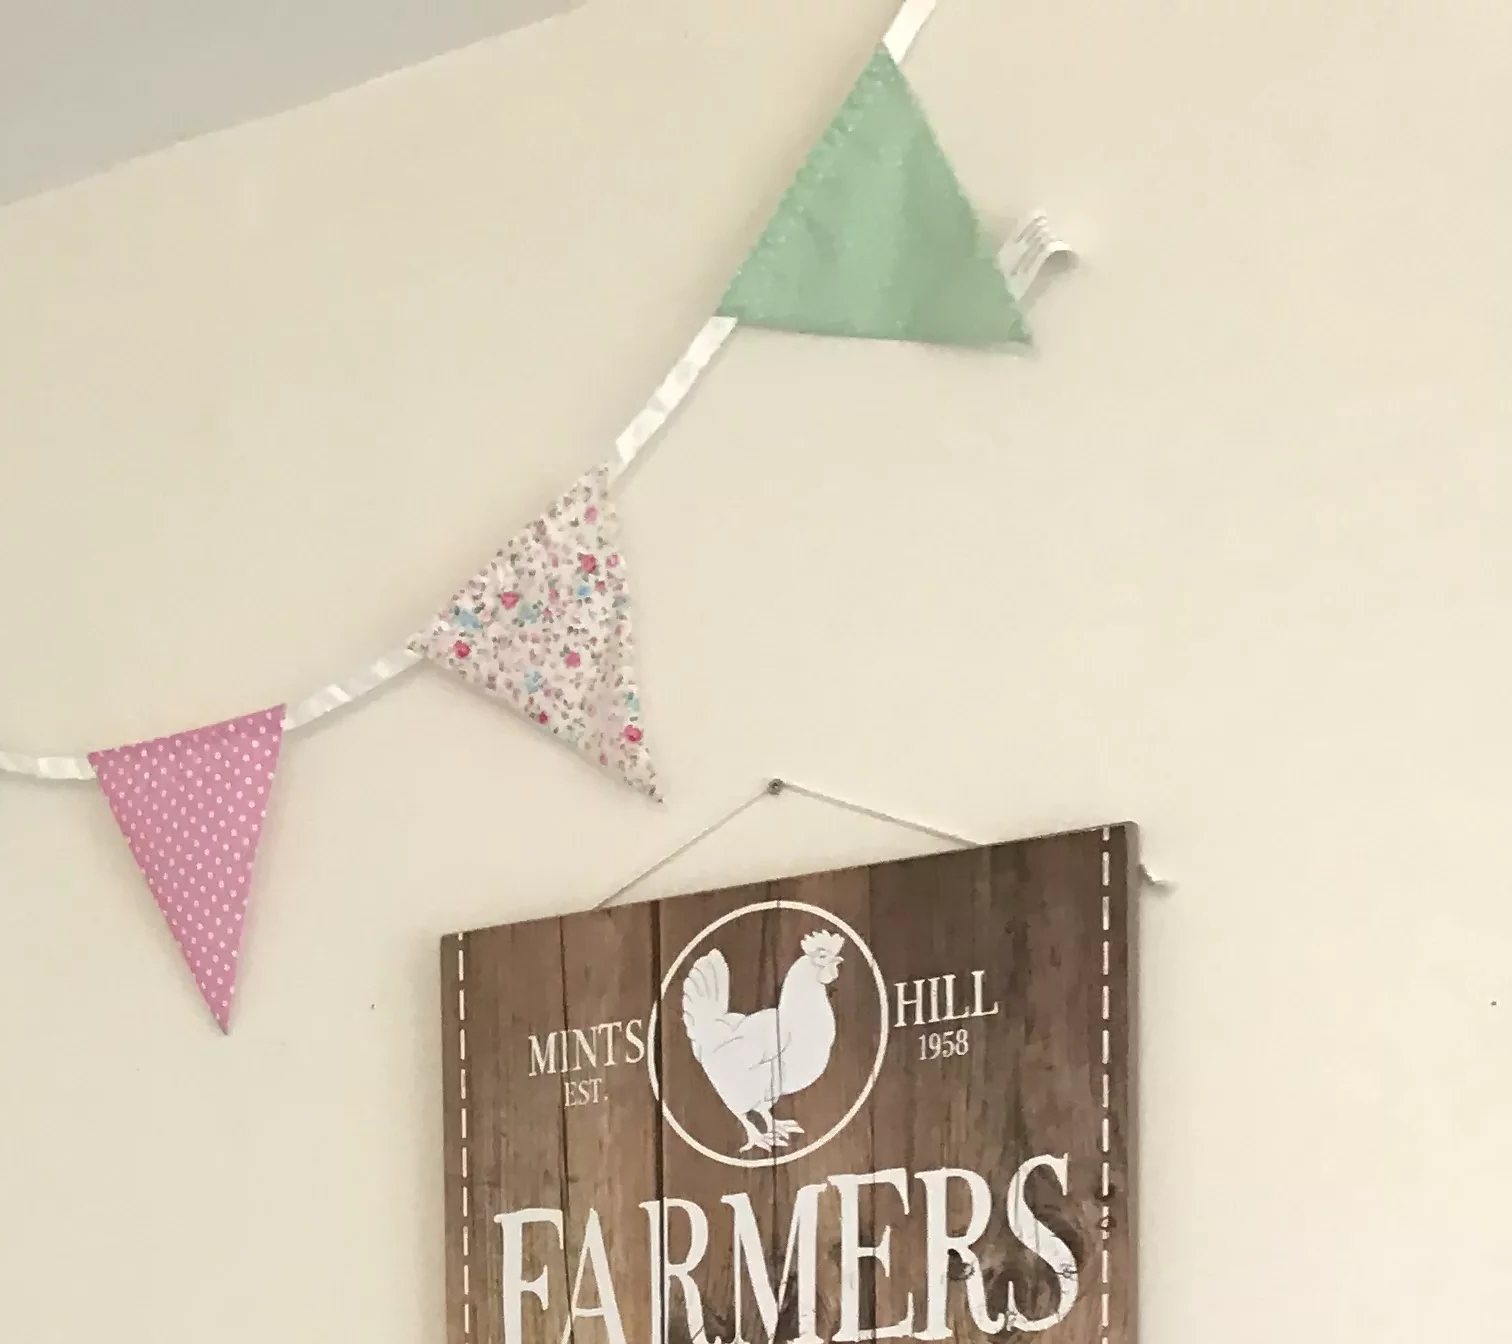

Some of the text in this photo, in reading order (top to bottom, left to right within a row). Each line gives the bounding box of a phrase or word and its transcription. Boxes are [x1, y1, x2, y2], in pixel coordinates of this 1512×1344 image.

[893, 969, 999, 1028] HILL
[528, 1018, 646, 1077] MINTS
[917, 1029, 970, 1061] 1958
[564, 1077, 609, 1108] EST.
